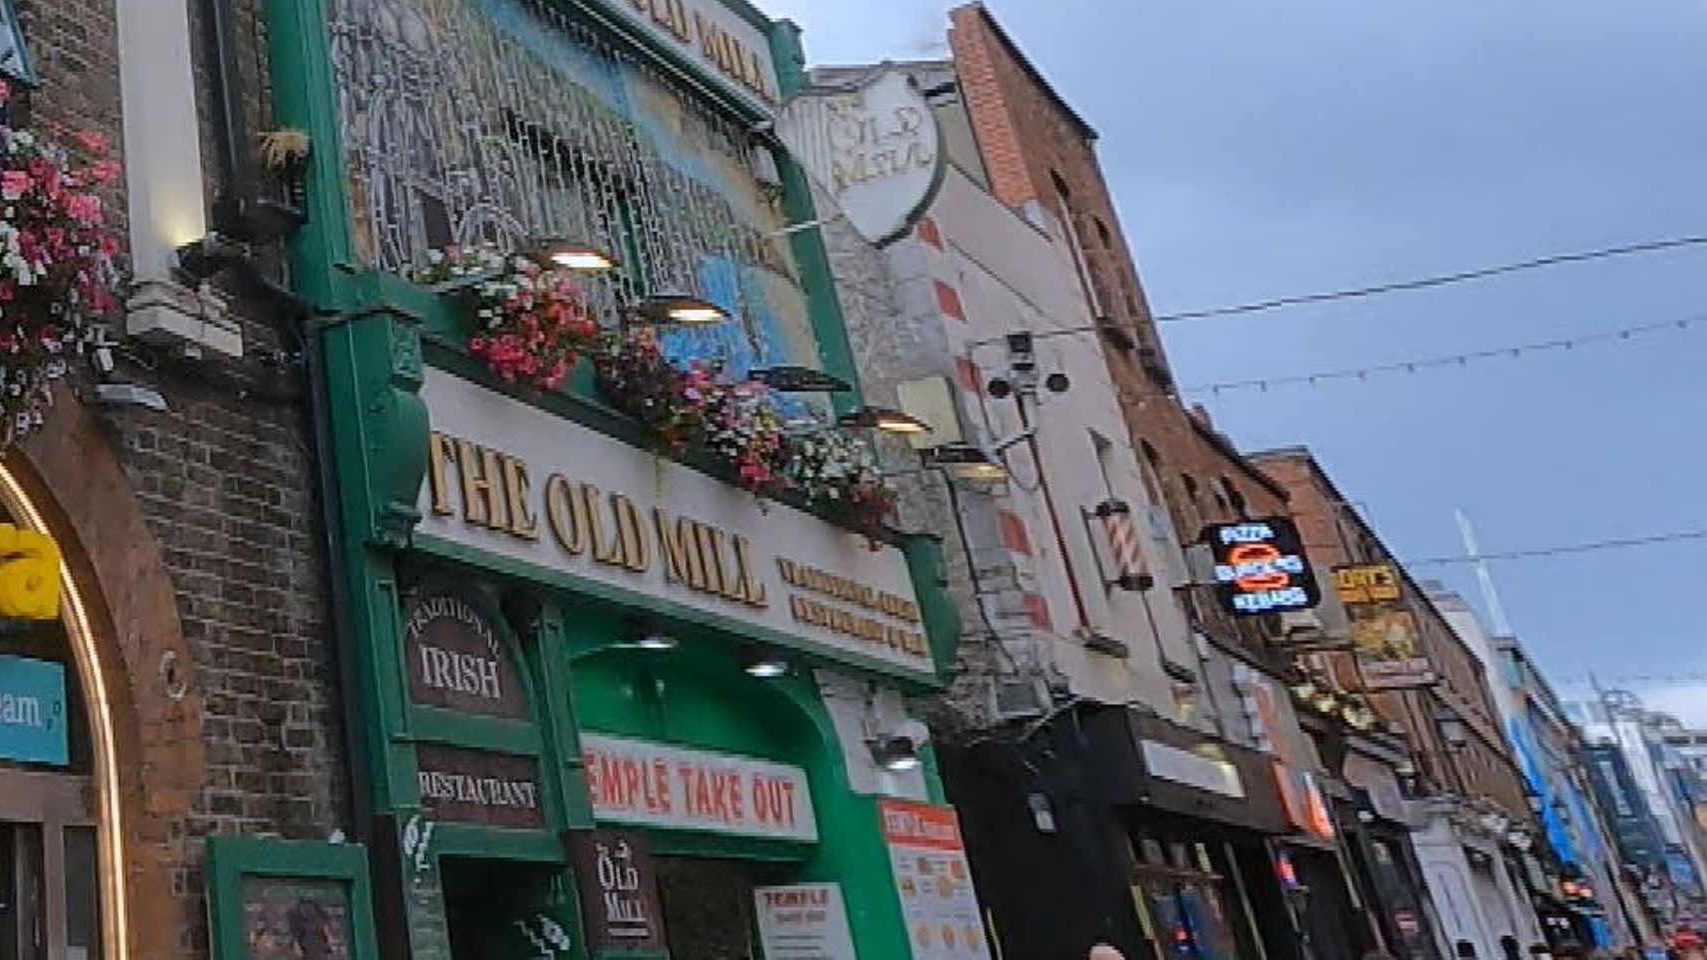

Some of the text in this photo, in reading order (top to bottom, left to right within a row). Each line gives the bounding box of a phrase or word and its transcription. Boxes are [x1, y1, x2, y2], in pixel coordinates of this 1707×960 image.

[694, 9, 777, 105] MILL
[427, 431, 769, 608] THE OLD MILL
[1220, 524, 1275, 544] PIZZA
[418, 643, 501, 700] IRISH
[418, 771, 536, 809] RESTAURANT
[678, 766, 744, 823] TAKE
[751, 772, 799, 828] OUT
